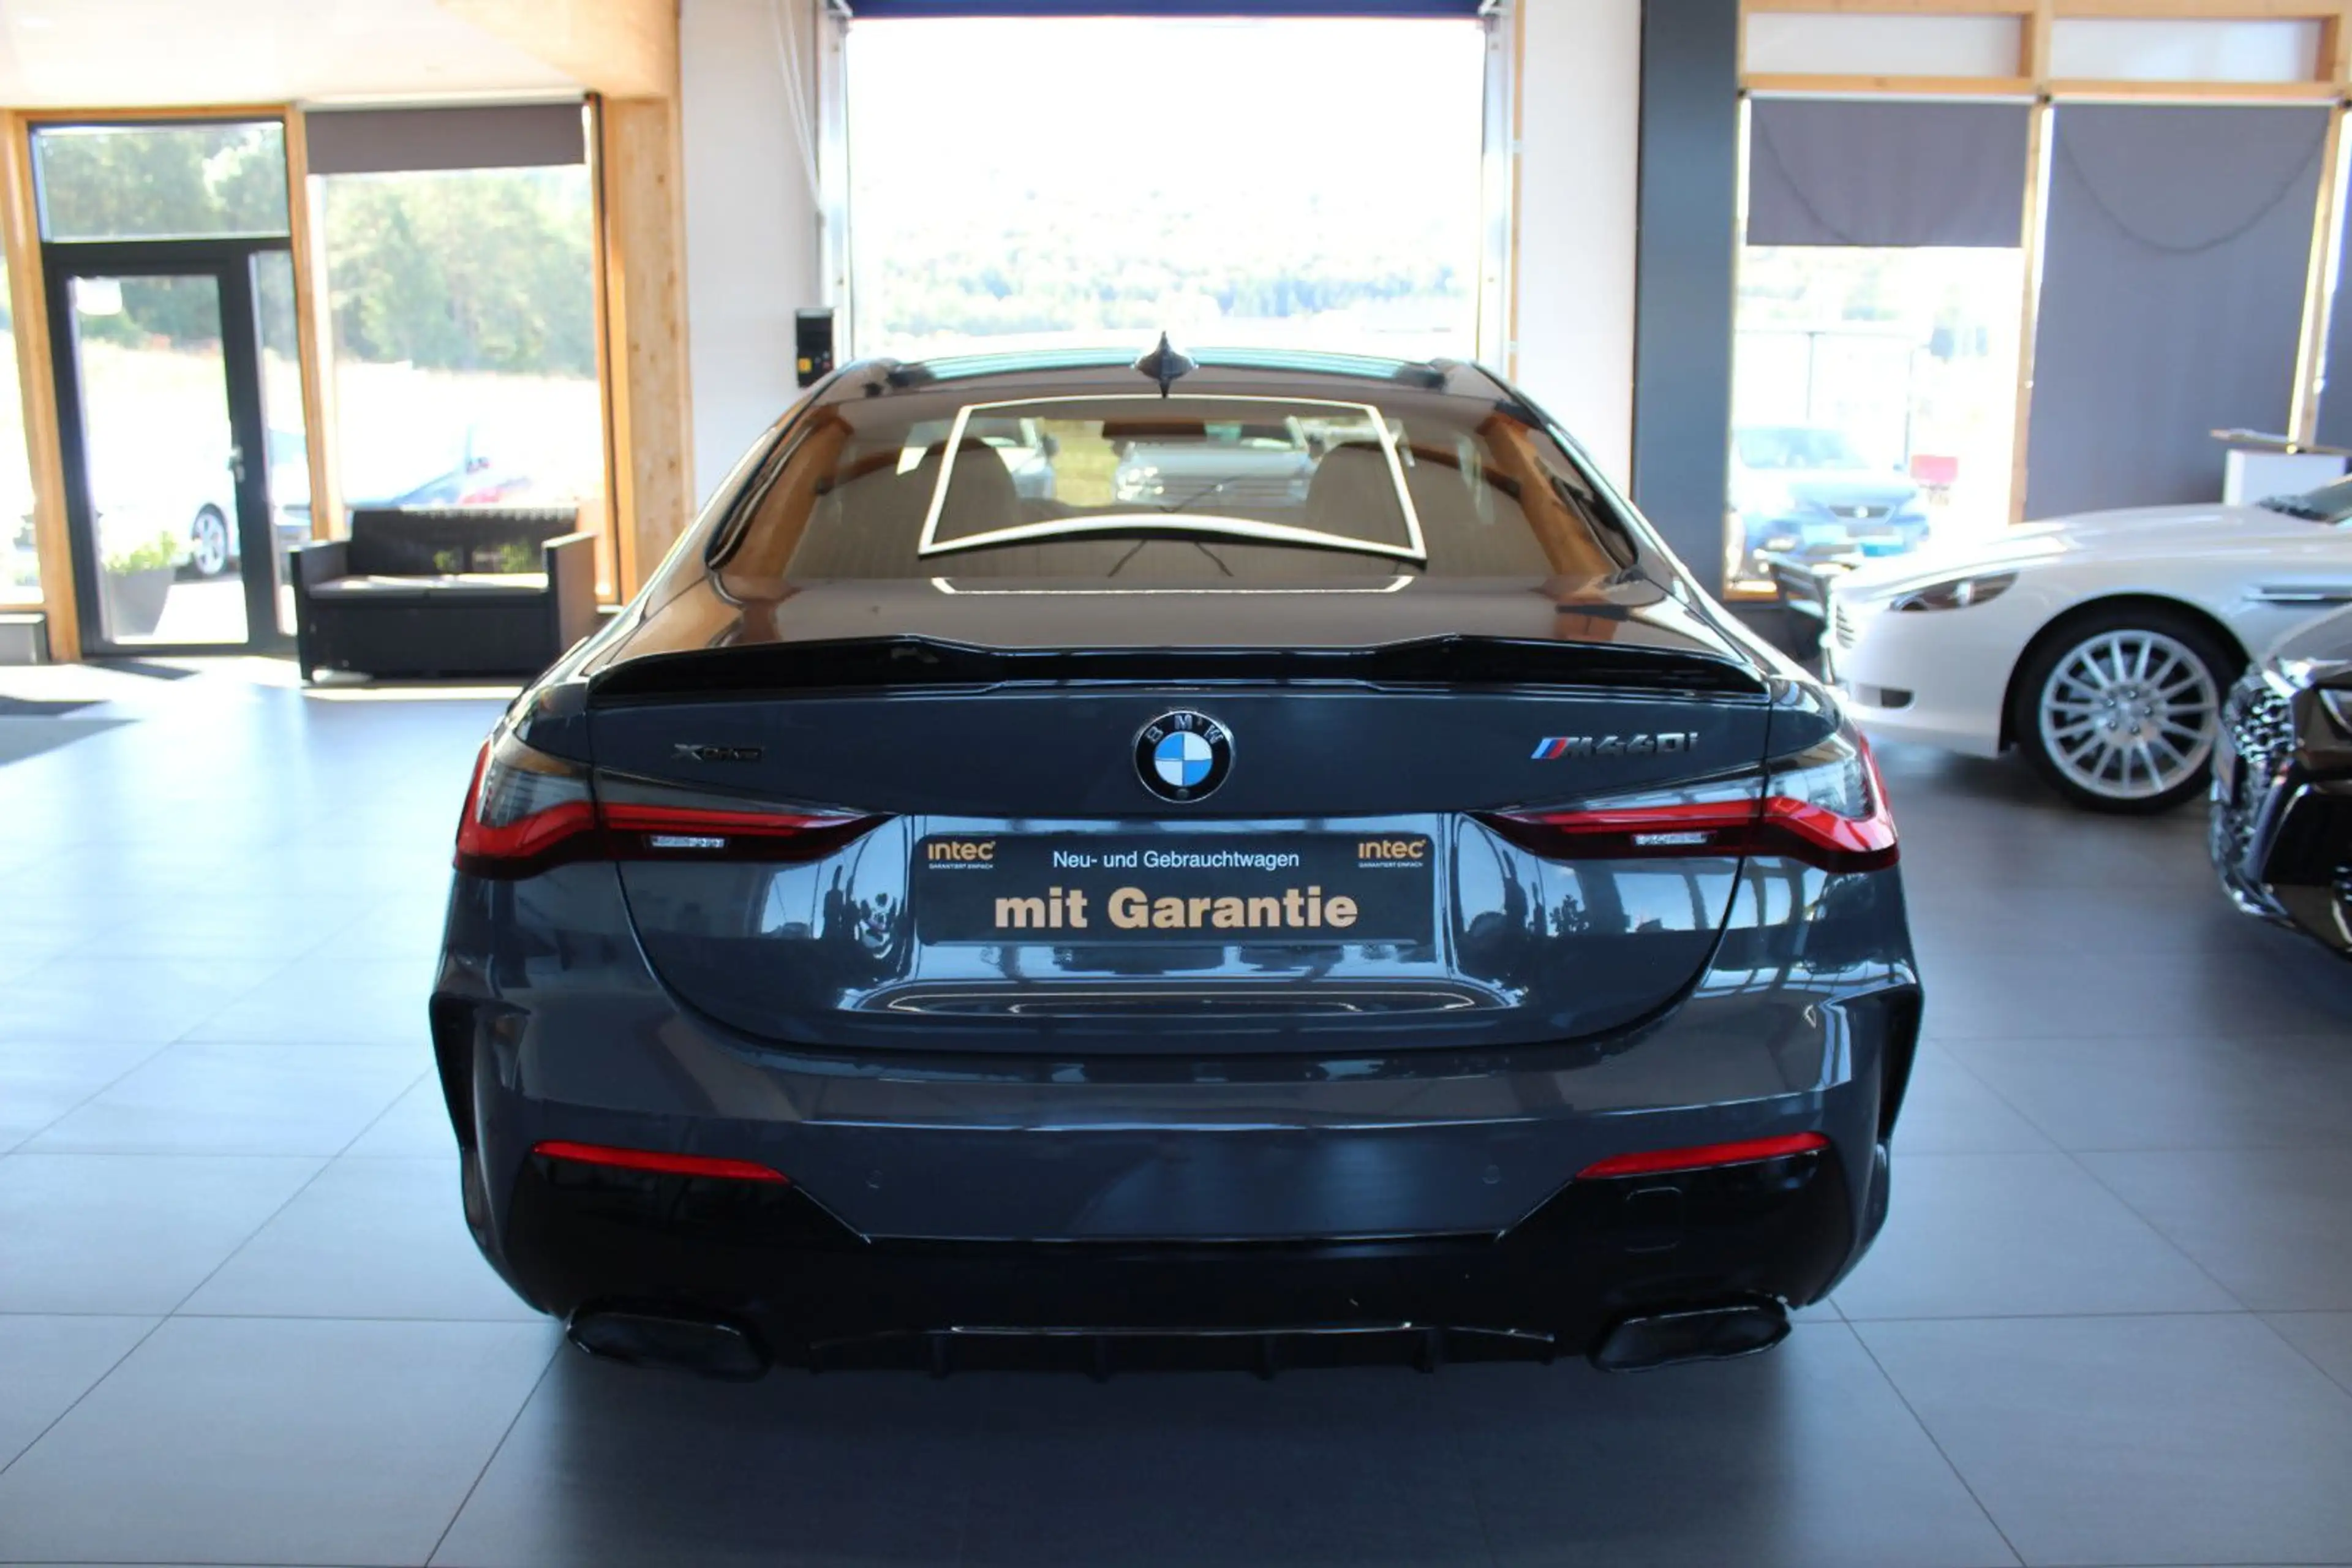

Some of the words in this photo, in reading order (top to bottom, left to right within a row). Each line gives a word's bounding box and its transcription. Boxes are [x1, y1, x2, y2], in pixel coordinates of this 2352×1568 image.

[1145, 714, 1224, 744] BMW
[1561, 732, 1698, 758] M440i
[928, 841, 996, 861] intec
[1053, 851, 1098, 869] Neu-
[1103, 851, 1137, 868] und
[1143, 850, 1299, 871] Gebrauchtwagen
[1359, 839, 1427, 859] intec
[995, 886, 1087, 928] mit
[1108, 886, 1357, 929] Garantie
